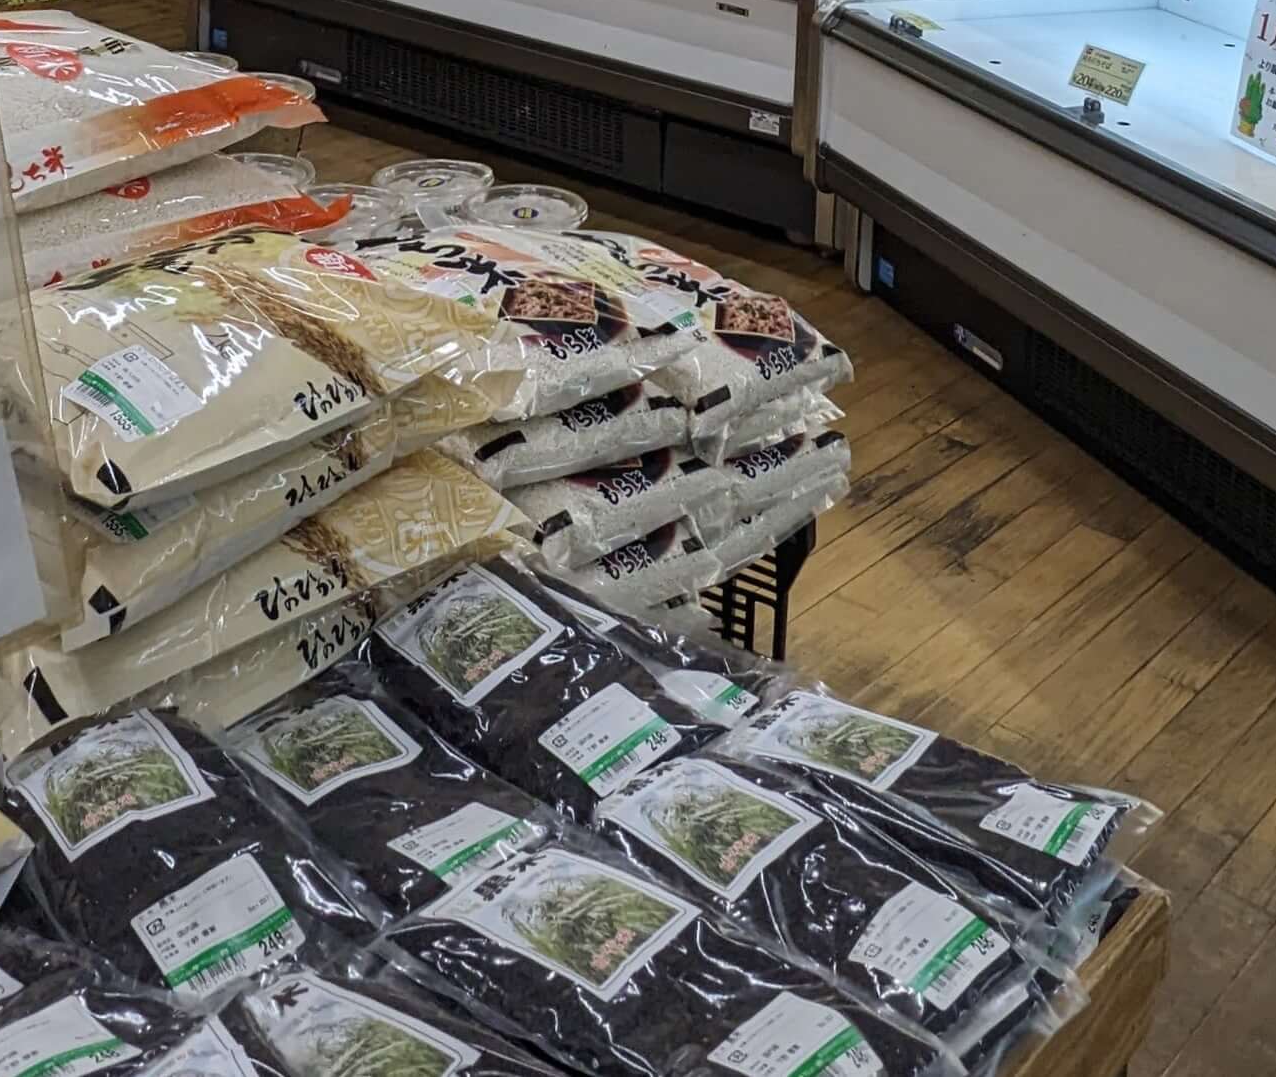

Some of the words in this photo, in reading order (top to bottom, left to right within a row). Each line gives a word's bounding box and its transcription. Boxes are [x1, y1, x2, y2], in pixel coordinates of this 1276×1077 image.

[547, 329, 602, 360] もち米
[757, 347, 798, 381] もち米
[294, 373, 367, 421] ひのひかり
[734, 445, 787, 479] もち米
[599, 471, 652, 505] もち米
[601, 546, 653, 581] もち米
[255, 554, 349, 621] ひのひかり
[645, 732, 668, 753] 248
[257, 930, 288, 958] 248
